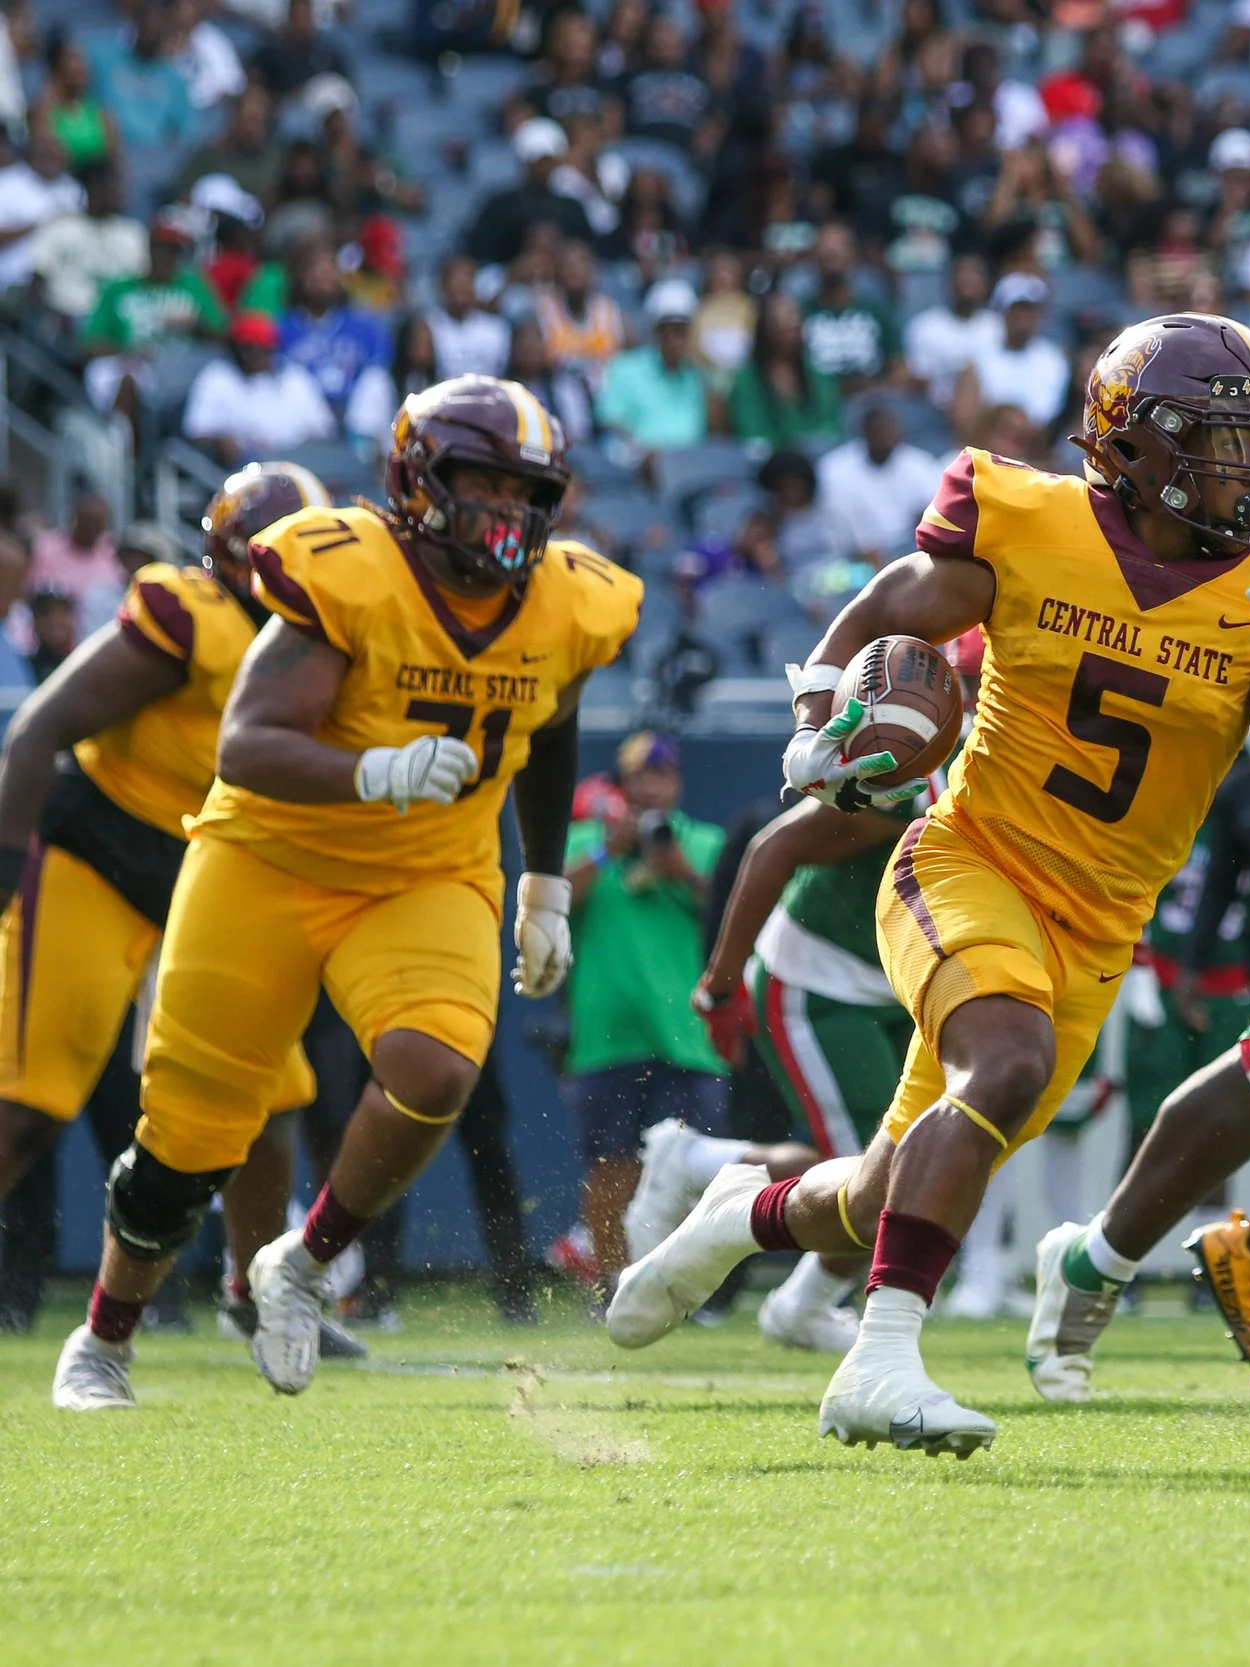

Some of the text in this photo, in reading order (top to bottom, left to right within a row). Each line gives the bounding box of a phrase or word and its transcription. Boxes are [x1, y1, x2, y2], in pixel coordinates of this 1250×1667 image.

[296, 519, 360, 554] 71
[396, 662, 537, 702] CENTRAL STATE
[1037, 597, 1233, 685] CENTRAL STATE
[404, 699, 513, 800] 71
[1042, 651, 1171, 824] 5
